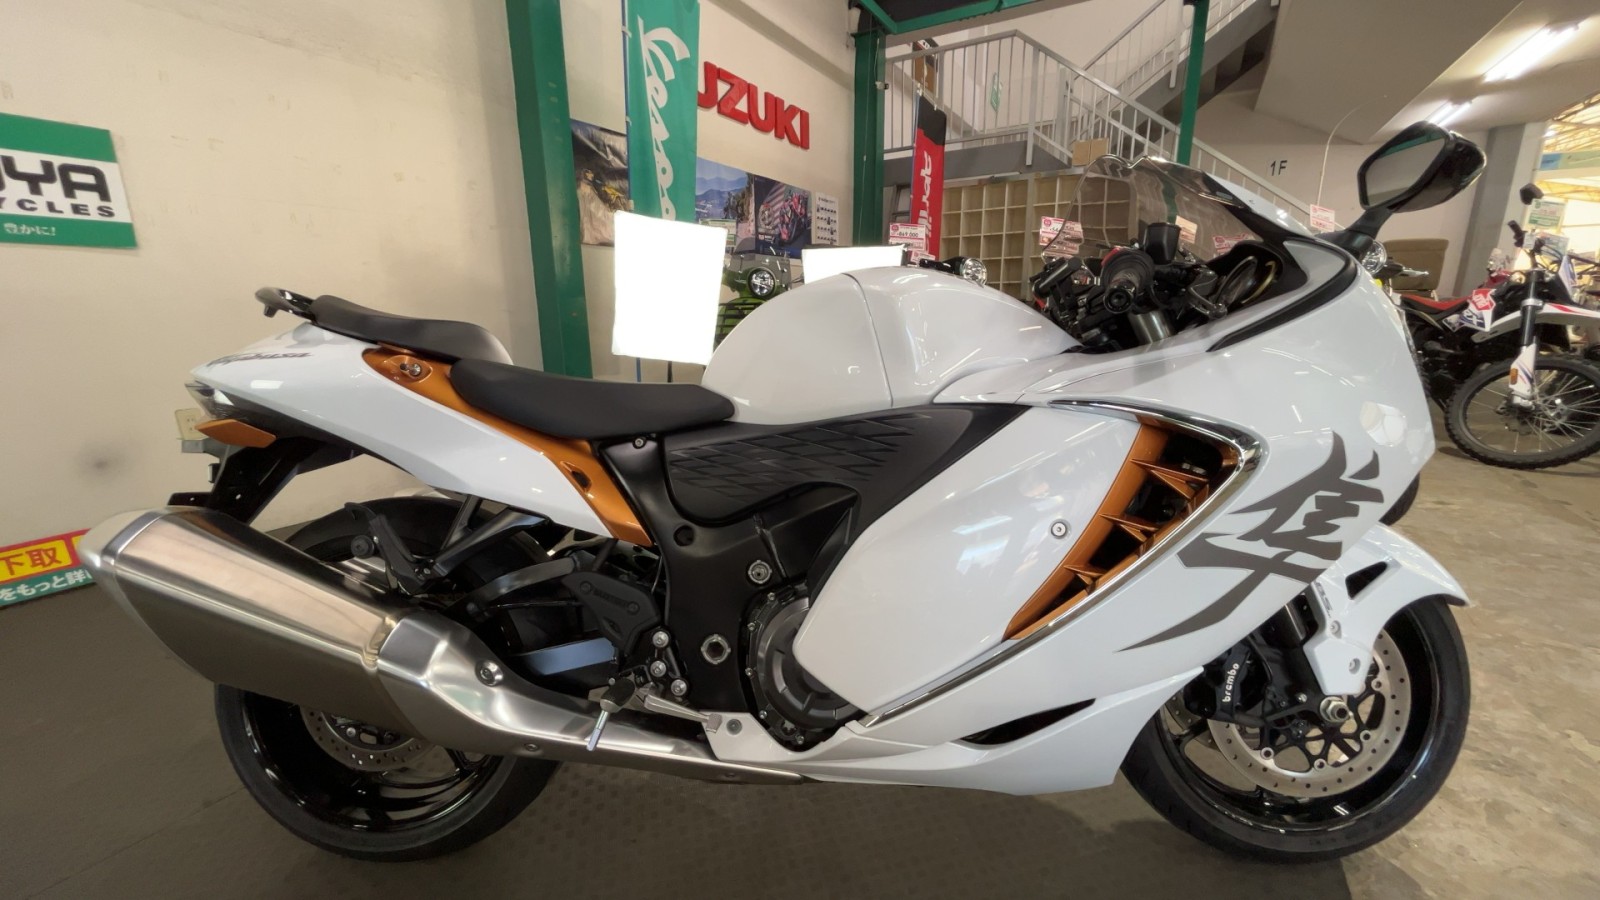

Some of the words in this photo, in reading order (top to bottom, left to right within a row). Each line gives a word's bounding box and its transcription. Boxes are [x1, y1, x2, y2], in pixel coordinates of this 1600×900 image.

[0, 155, 111, 202] YA
[1270, 159, 1287, 176] 1F
[1222, 663, 1239, 703] brembo
